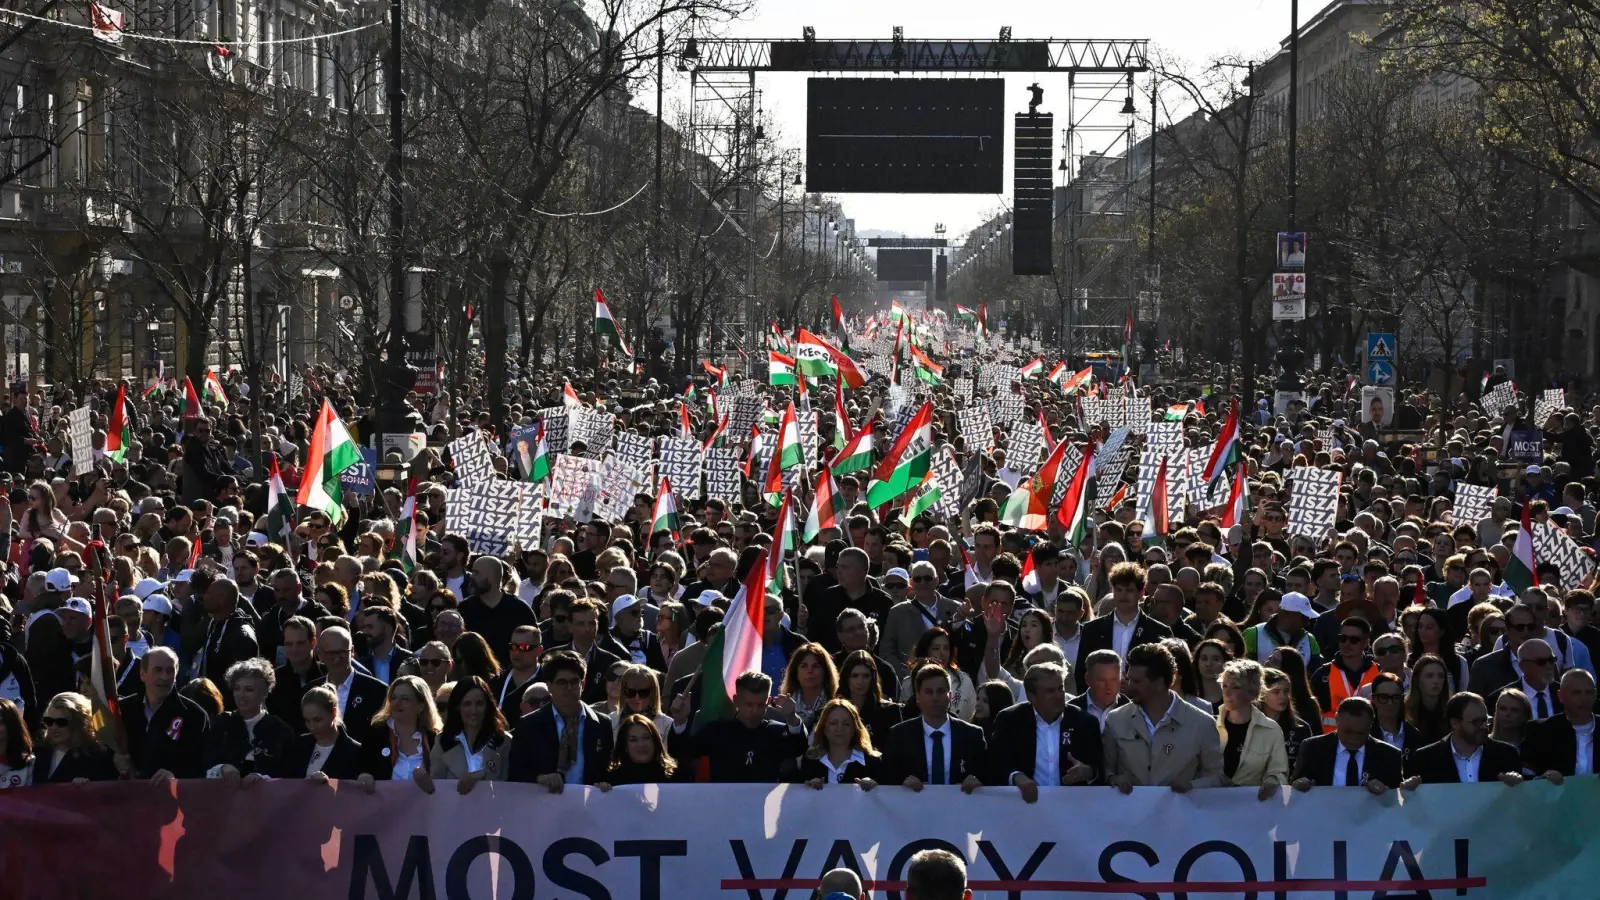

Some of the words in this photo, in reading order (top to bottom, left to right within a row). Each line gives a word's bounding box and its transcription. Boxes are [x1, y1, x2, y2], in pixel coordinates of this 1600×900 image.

[1126, 397, 1151, 405] TISZA
[958, 405, 988, 419] TISZA
[1100, 406, 1124, 414] TISZA
[1126, 412, 1151, 420] TISZA
[960, 414, 990, 427] TISZA
[1012, 420, 1044, 434] TISZA
[1148, 422, 1183, 433] TISZA
[961, 423, 993, 436] TISZA
[448, 429, 483, 454] TISZA
[619, 430, 652, 447] TISZA
[964, 431, 994, 444] TISZA
[1010, 430, 1043, 444] TISZA
[1147, 433, 1183, 444] TISZA
[617, 441, 652, 458] TISZA
[660, 439, 702, 451] TISZA
[970, 440, 995, 453] ISZA
[1008, 440, 1041, 453] TISZA
[1514, 441, 1540, 452] MOST
[452, 440, 489, 466] TISZA
[660, 450, 702, 462] TISZA
[706, 448, 738, 459] TISZA
[1006, 449, 1039, 464] TISZA
[1140, 448, 1188, 467] TISZA
[456, 452, 492, 478] TISZA
[615, 452, 652, 472] TISZA
[659, 462, 702, 475] TISZA
[706, 459, 739, 470] TISZA
[1004, 459, 1037, 473] TISZA
[461, 465, 498, 489] TISZA
[707, 470, 740, 481] TISZA
[1138, 465, 1188, 481] TIZA
[1295, 466, 1341, 483] TISZA
[341, 475, 369, 486] SOHA!
[658, 474, 701, 487] TSZA
[707, 481, 740, 492] TISZA
[1137, 479, 1187, 496] TIZA
[472, 479, 521, 498] TISZA
[672, 488, 701, 500] SZA
[1293, 480, 1340, 497] TISZA
[1456, 482, 1498, 499] TISZA
[470, 494, 520, 513] TISZA
[1136, 493, 1185, 509] TIZA
[1291, 494, 1338, 511] TISZA
[1454, 494, 1487, 508] TISZ
[468, 510, 520, 528] TISZA
[1135, 507, 1185, 523] TZA
[1289, 508, 1336, 525] TISZA
[1452, 506, 1492, 520] TISZA
[467, 525, 518, 543] TISZA
[469, 540, 515, 556] TISZA
[351, 834, 688, 900] MOST
[1097, 838, 1471, 900] SOHA!
